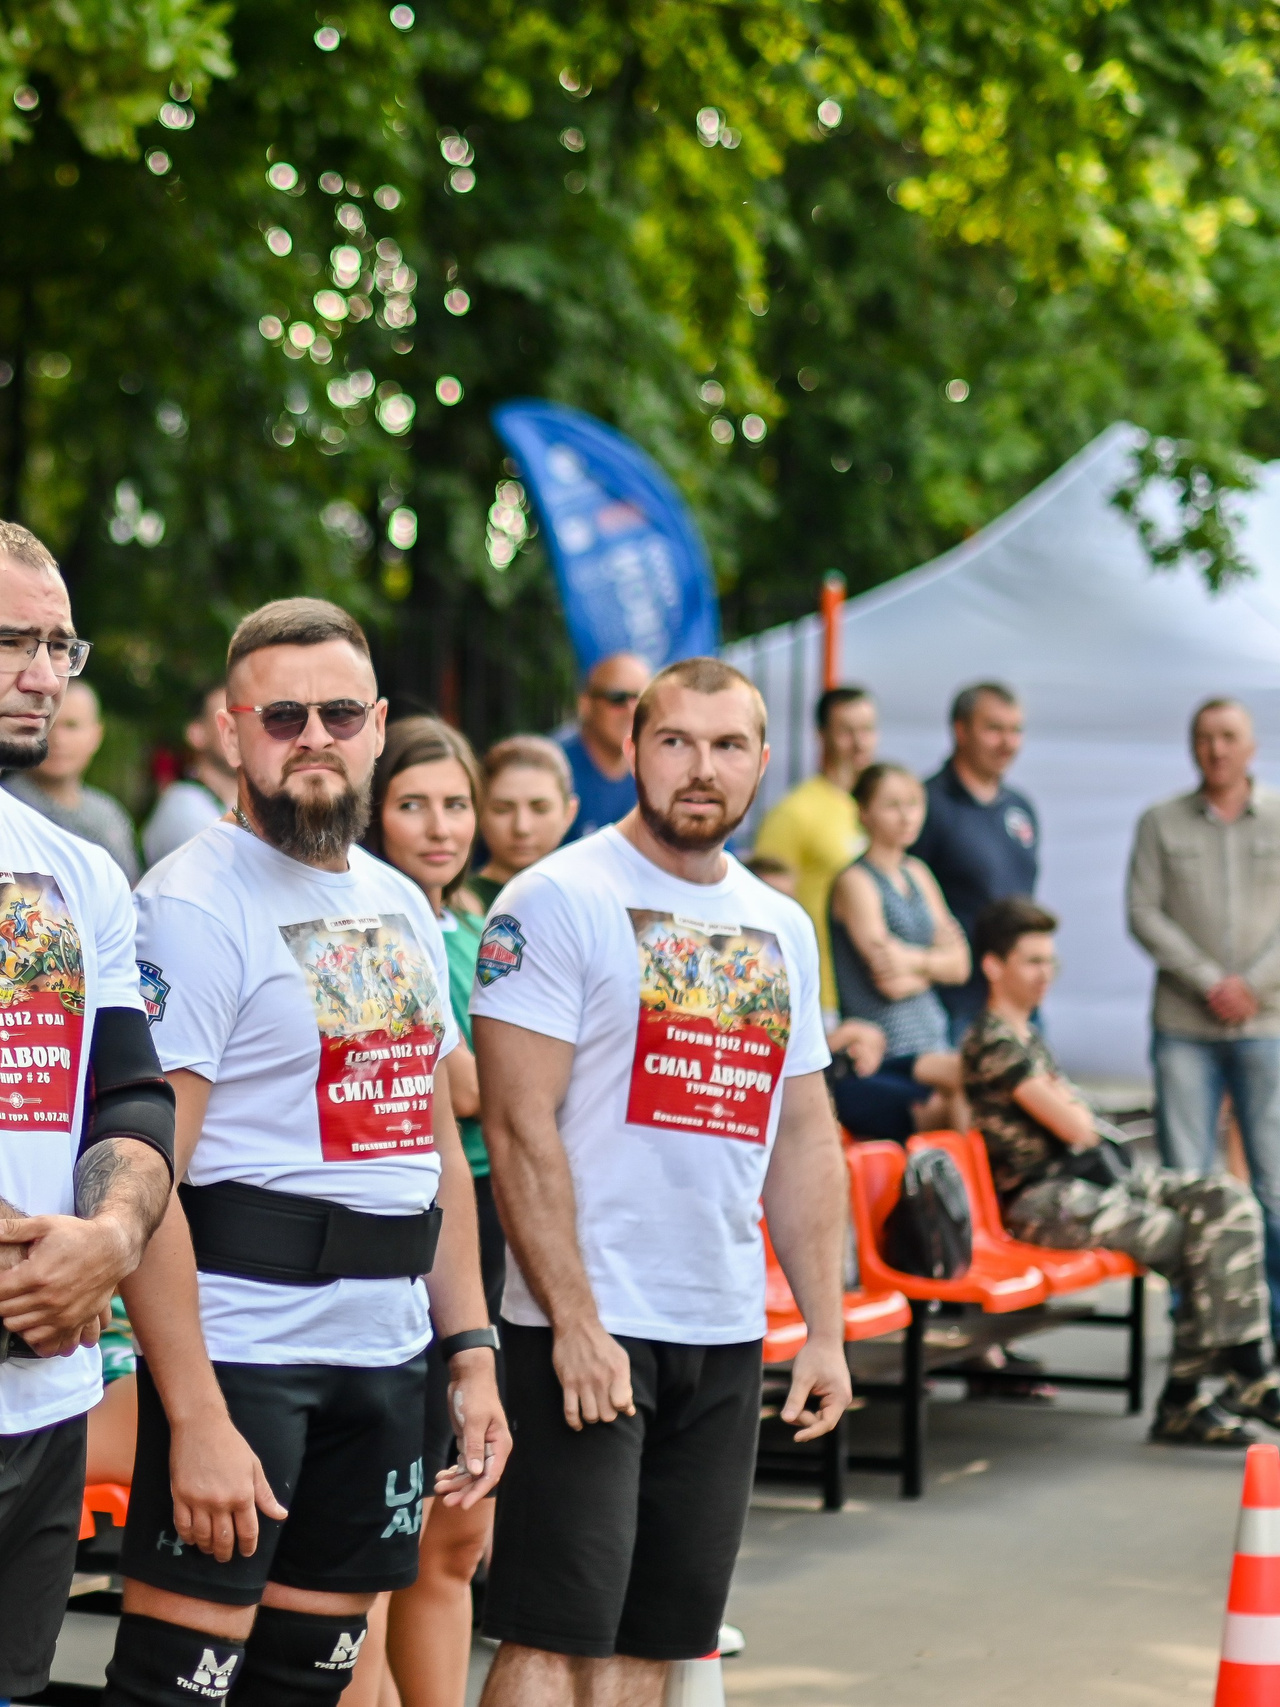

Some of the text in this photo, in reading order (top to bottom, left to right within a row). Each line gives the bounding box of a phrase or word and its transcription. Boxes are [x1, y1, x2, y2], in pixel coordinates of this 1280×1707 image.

[715, 1034, 741, 1052] 1812
[644, 1052, 702, 1080] СИЛА
[36, 1072, 51, 1084] 26
[328, 1079, 384, 1104] СИЛА
[418, 1099, 428, 1111] 26
[314, 1661, 337, 1670] THE
[177, 1676, 200, 1692] THE
